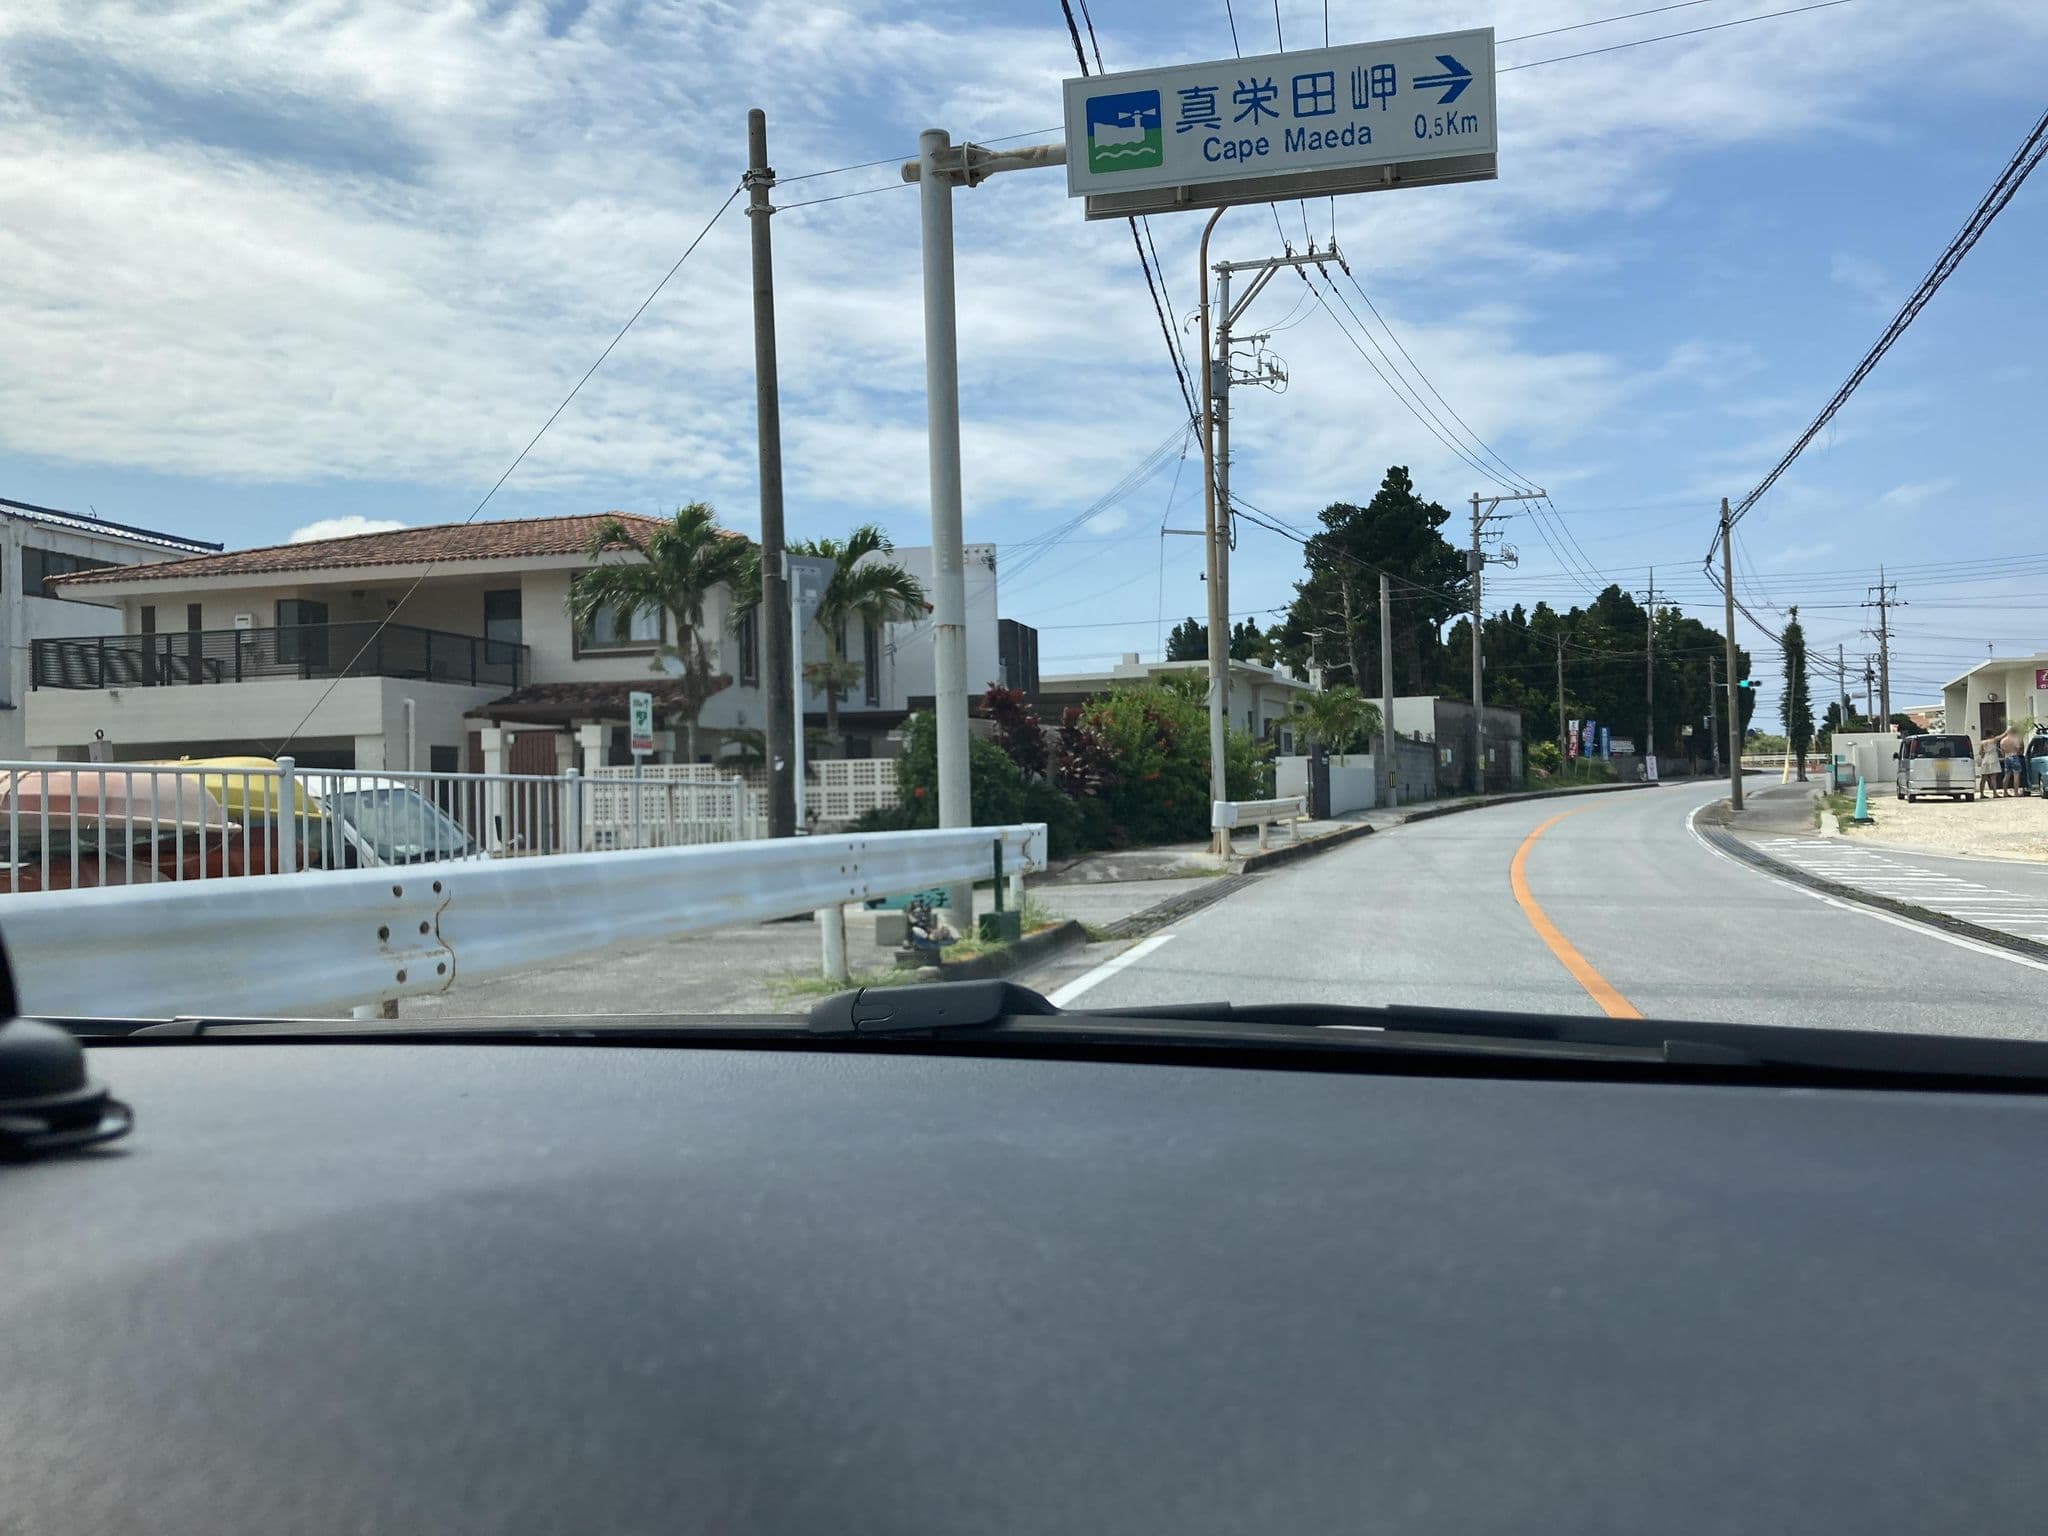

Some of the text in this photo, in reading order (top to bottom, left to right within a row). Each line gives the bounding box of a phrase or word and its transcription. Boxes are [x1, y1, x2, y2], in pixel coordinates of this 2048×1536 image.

[1175, 63, 1397, 134] 真栄田岬
[1202, 121, 1373, 164] Cape Maeda
[1414, 110, 1479, 140] 0.5Km
